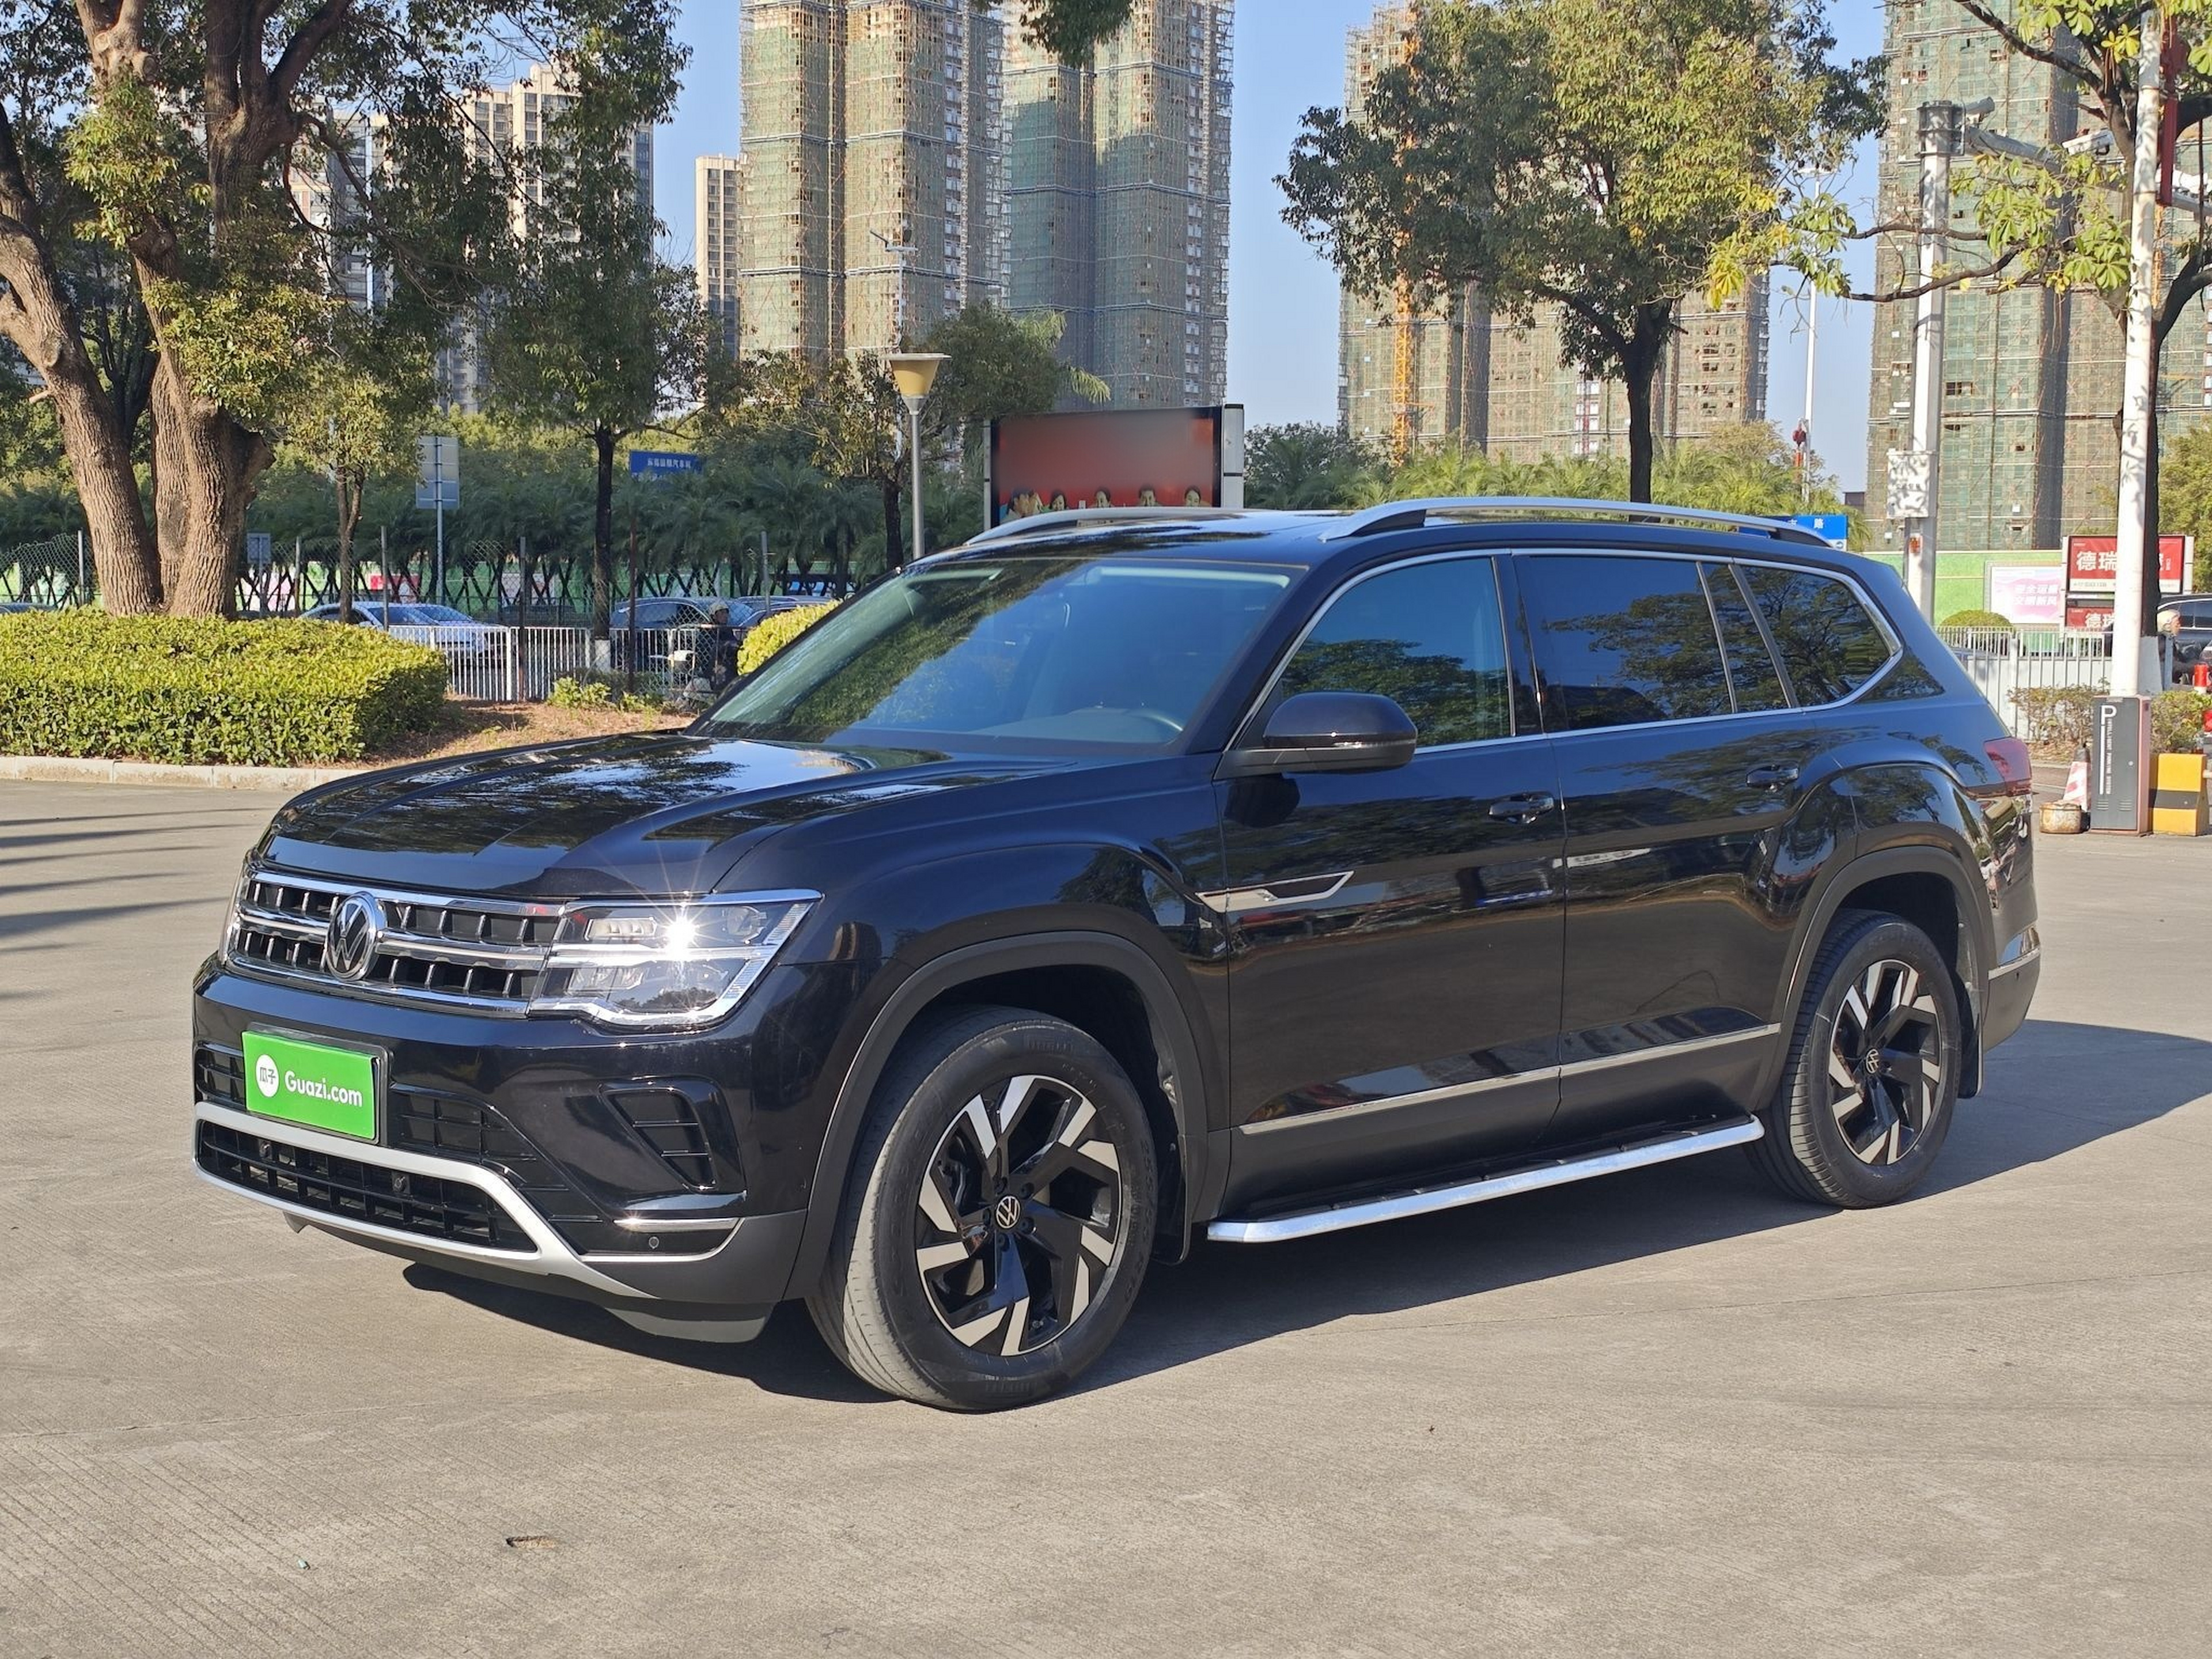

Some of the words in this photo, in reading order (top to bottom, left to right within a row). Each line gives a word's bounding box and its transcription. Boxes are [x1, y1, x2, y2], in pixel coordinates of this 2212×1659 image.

[2101, 705, 2117, 725] P
[259, 1066, 276, 1085] 瓜子
[285, 1070, 363, 1107] Guazi.com
